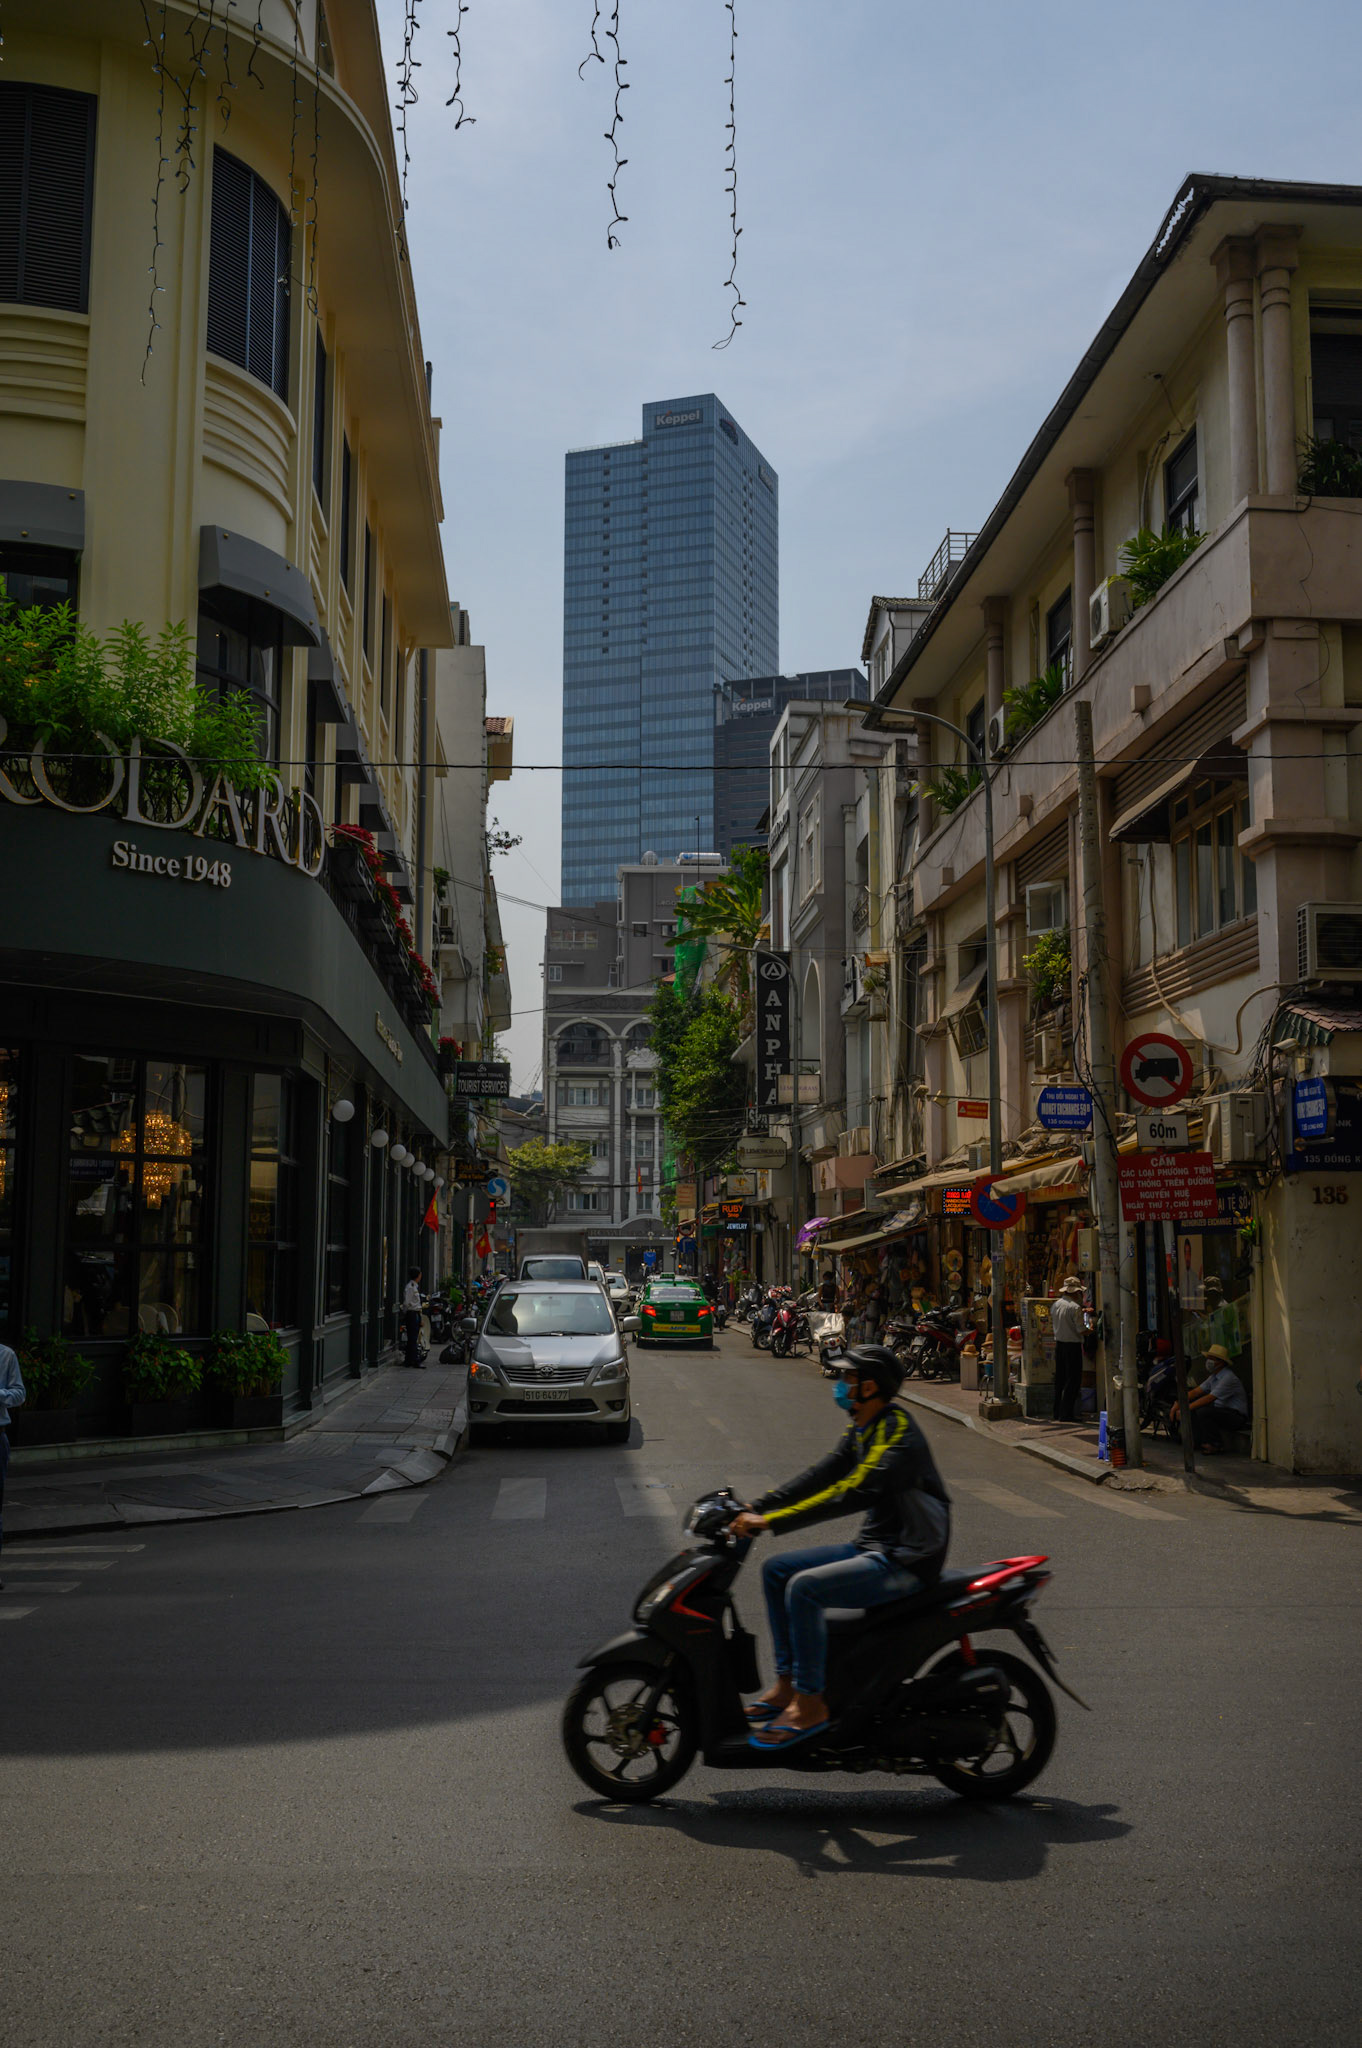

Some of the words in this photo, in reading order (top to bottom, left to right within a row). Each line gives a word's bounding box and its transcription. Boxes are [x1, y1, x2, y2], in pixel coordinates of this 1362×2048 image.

[656, 409, 700, 426] Keppel
[732, 698, 772, 712] Keppel
[112, 840, 181, 878] Since
[184, 855, 232, 888] 1948
[458, 1080, 480, 1094] TOURIST
[481, 1080, 508, 1095] SERVICES
[1041, 1102, 1055, 1116] MONEY
[1056, 1102, 1079, 1116] EXCHANGE
[1150, 1122, 1177, 1139] 60m
[1151, 1154, 1176, 1168] CẤM
[1304, 1155, 1321, 1163] 135
[1324, 1153, 1352, 1163] ĐỒNG
[1121, 1168, 1135, 1178] CÁC
[1138, 1168, 1155, 1179] LOẠI
[1120, 1179, 1134, 1189] LƯU
[1137, 1178, 1161, 1188] THÔNG
[1165, 1177, 1185, 1187] TRÊN
[1140, 1188, 1170, 1199] NGUYỄN
[1174, 1188, 1190, 1199] HUỆ
[1312, 1186, 1349, 1205] 135
[722, 1204, 744, 1213] RUBY
[1126, 1199, 1144, 1209] NGÀY
[1193, 1198, 1213, 1210] NHẬT
[1136, 1210, 1146, 1220] TỪ
[726, 1222, 748, 1230] JEWELRY
[1181, 1218, 1207, 1227] AUTHORIZED
[1208, 1217, 1233, 1226] EXCHANGE
